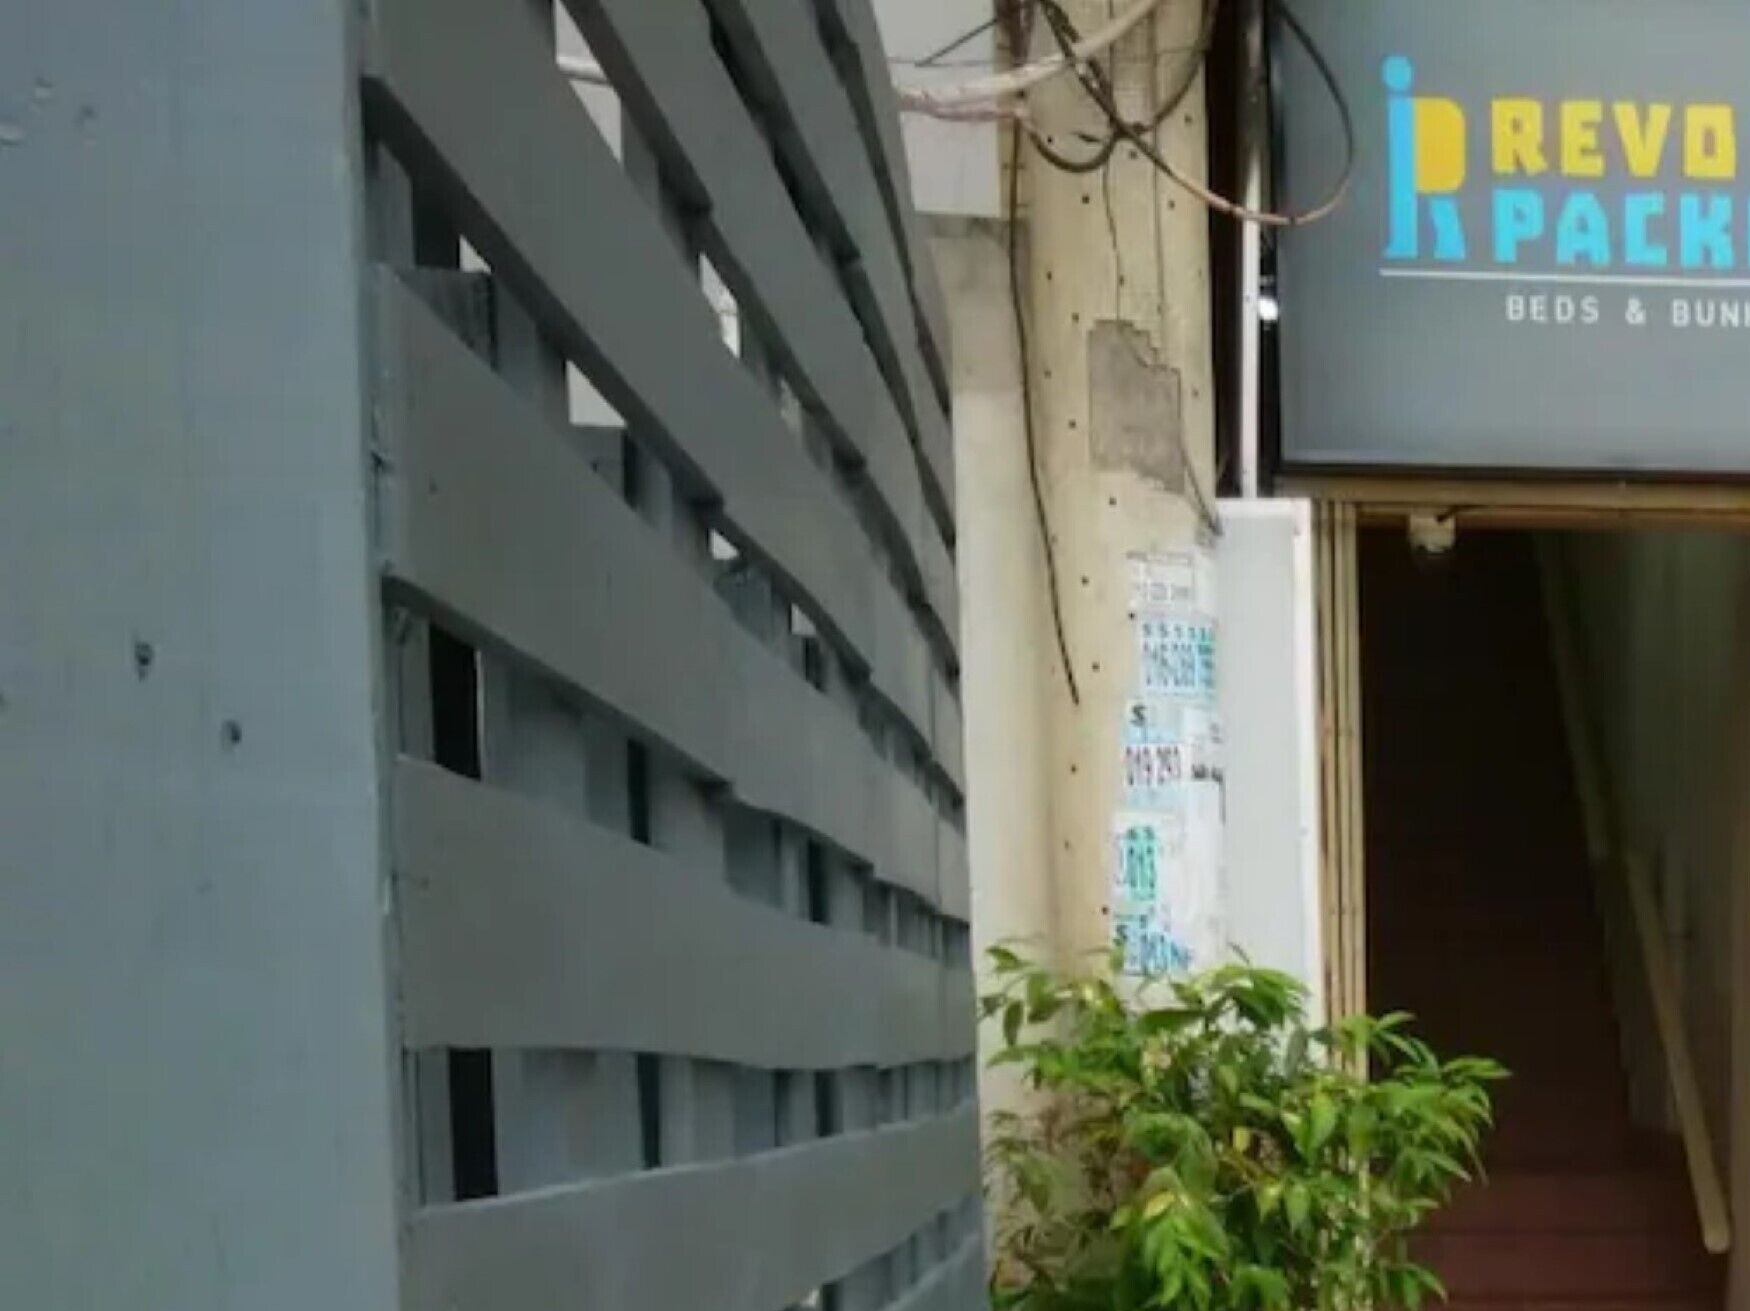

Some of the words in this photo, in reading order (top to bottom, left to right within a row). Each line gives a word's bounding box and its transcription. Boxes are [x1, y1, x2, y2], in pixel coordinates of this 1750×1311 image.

[1491, 97, 1736, 179] REVO
[1506, 295, 1600, 324] BEDS
[1624, 299, 1648, 326] &
